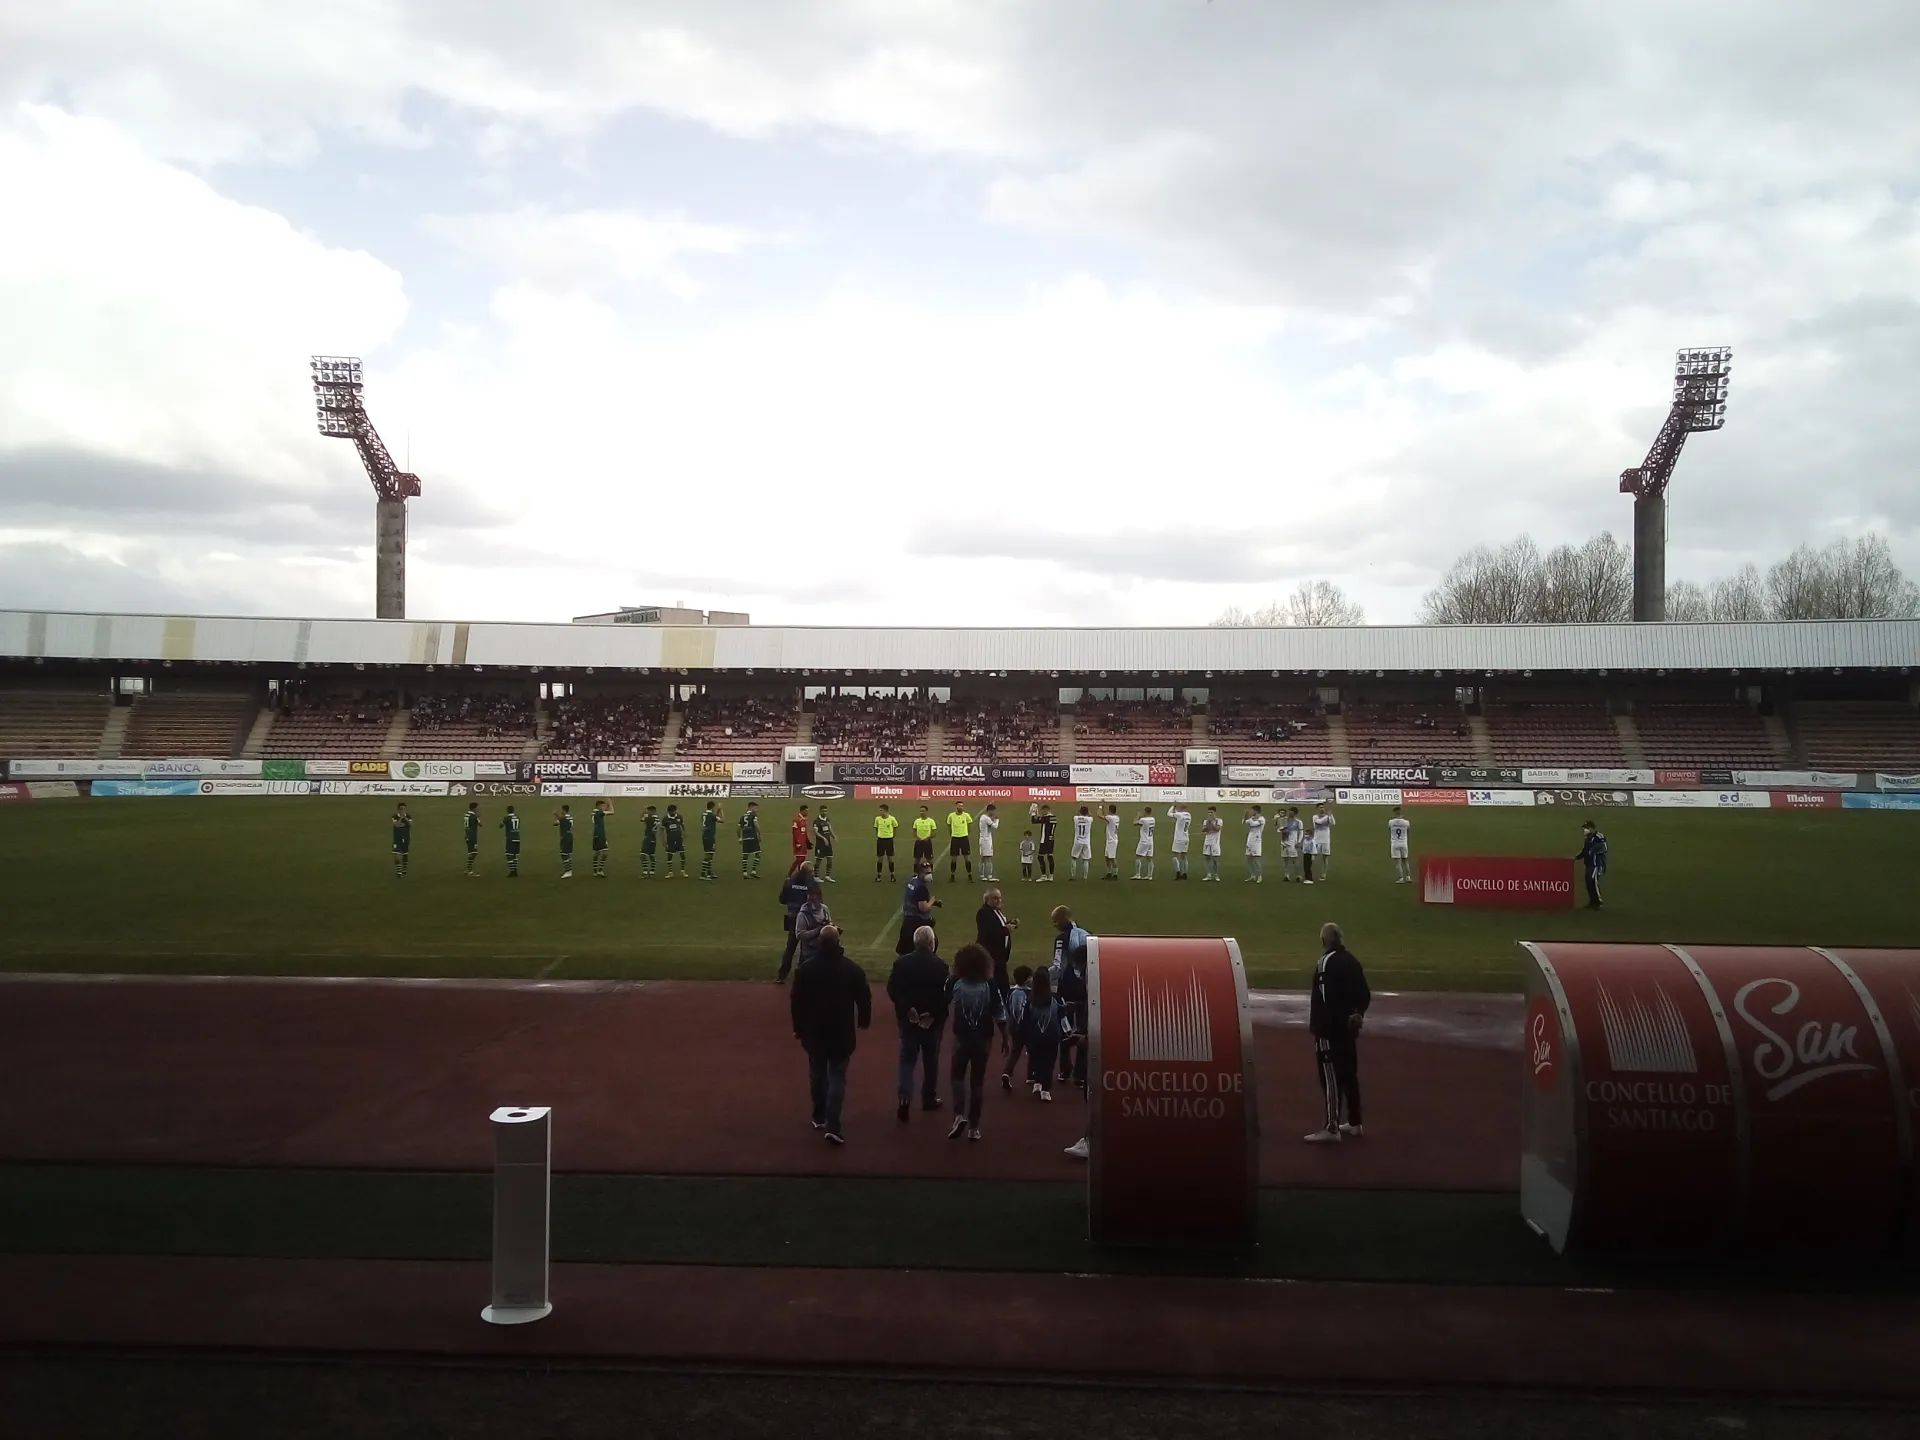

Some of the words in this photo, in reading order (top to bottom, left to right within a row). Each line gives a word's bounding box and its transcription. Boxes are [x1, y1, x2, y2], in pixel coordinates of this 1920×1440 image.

[149, 763, 201, 773] ABANCA
[352, 762, 388, 773] GADIS
[424, 762, 463, 776] fisela
[534, 763, 592, 776] FERRECAL
[693, 763, 731, 772] BOEL
[930, 766, 986, 777] FERRECAL
[1370, 768, 1430, 780] FERRECAL
[266, 782, 310, 796] JULIO
[322, 782, 352, 794] REY
[473, 782, 485, 792] O
[870, 786, 903, 795] Mahou
[1028, 788, 1061, 797] Mahou
[932, 789, 967, 797] CONCELLO
[968, 789, 977, 797] DE
[978, 789, 1011, 798] SANTIAGO
[1229, 789, 1261, 799] salgado
[1786, 794, 1825, 804] Mahou
[1078, 825, 1086, 836] 11
[1395, 828, 1402, 839] 9
[1456, 878, 1505, 891] CONCELLO
[1508, 879, 1519, 891] DE
[1523, 880, 1570, 892] SANTIAGO
[1733, 977, 1860, 1086] San
[1102, 1070, 1208, 1093] CONCELLO
[1218, 1073, 1243, 1093] DE
[1585, 1080, 1696, 1104] CONCELLO
[1705, 1083, 1732, 1105] DE
[1121, 1096, 1225, 1118] SANTIAGO
[1607, 1108, 1715, 1132] SANTIAGO
